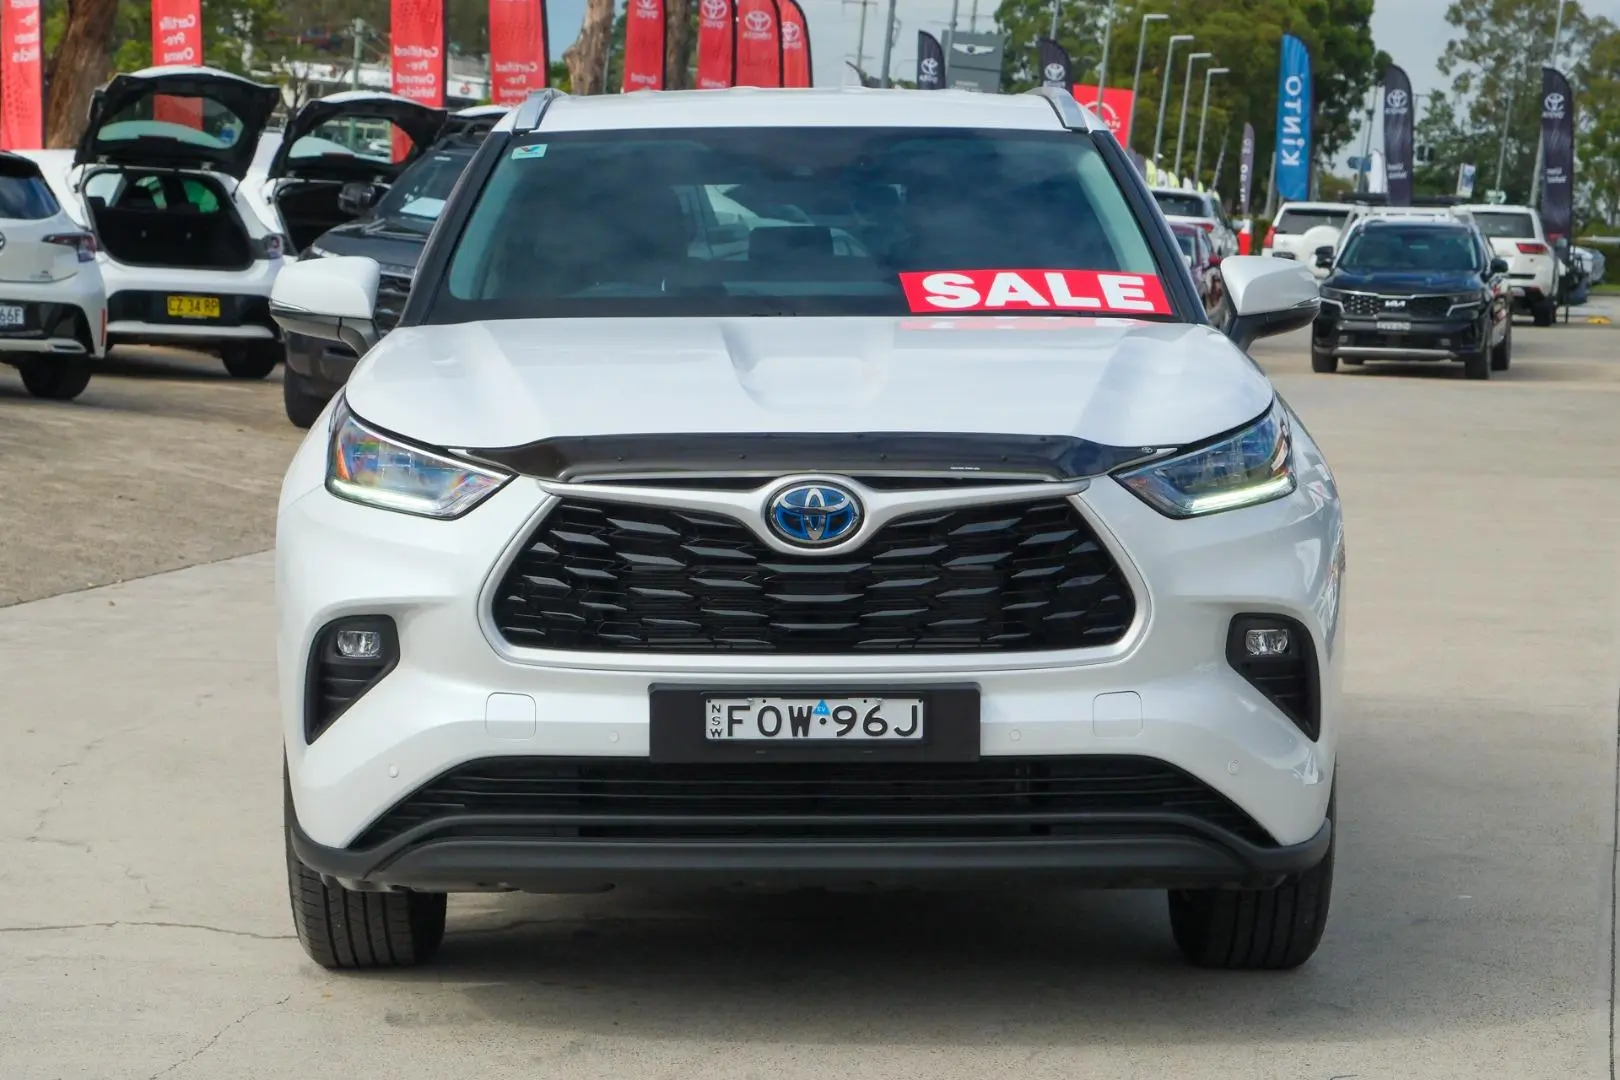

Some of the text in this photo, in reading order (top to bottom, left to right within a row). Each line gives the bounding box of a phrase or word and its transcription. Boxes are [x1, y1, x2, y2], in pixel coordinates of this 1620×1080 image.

[922, 272, 1155, 311] SALE
[188, 298, 201, 312] 34
[204, 298, 219, 312] RP
